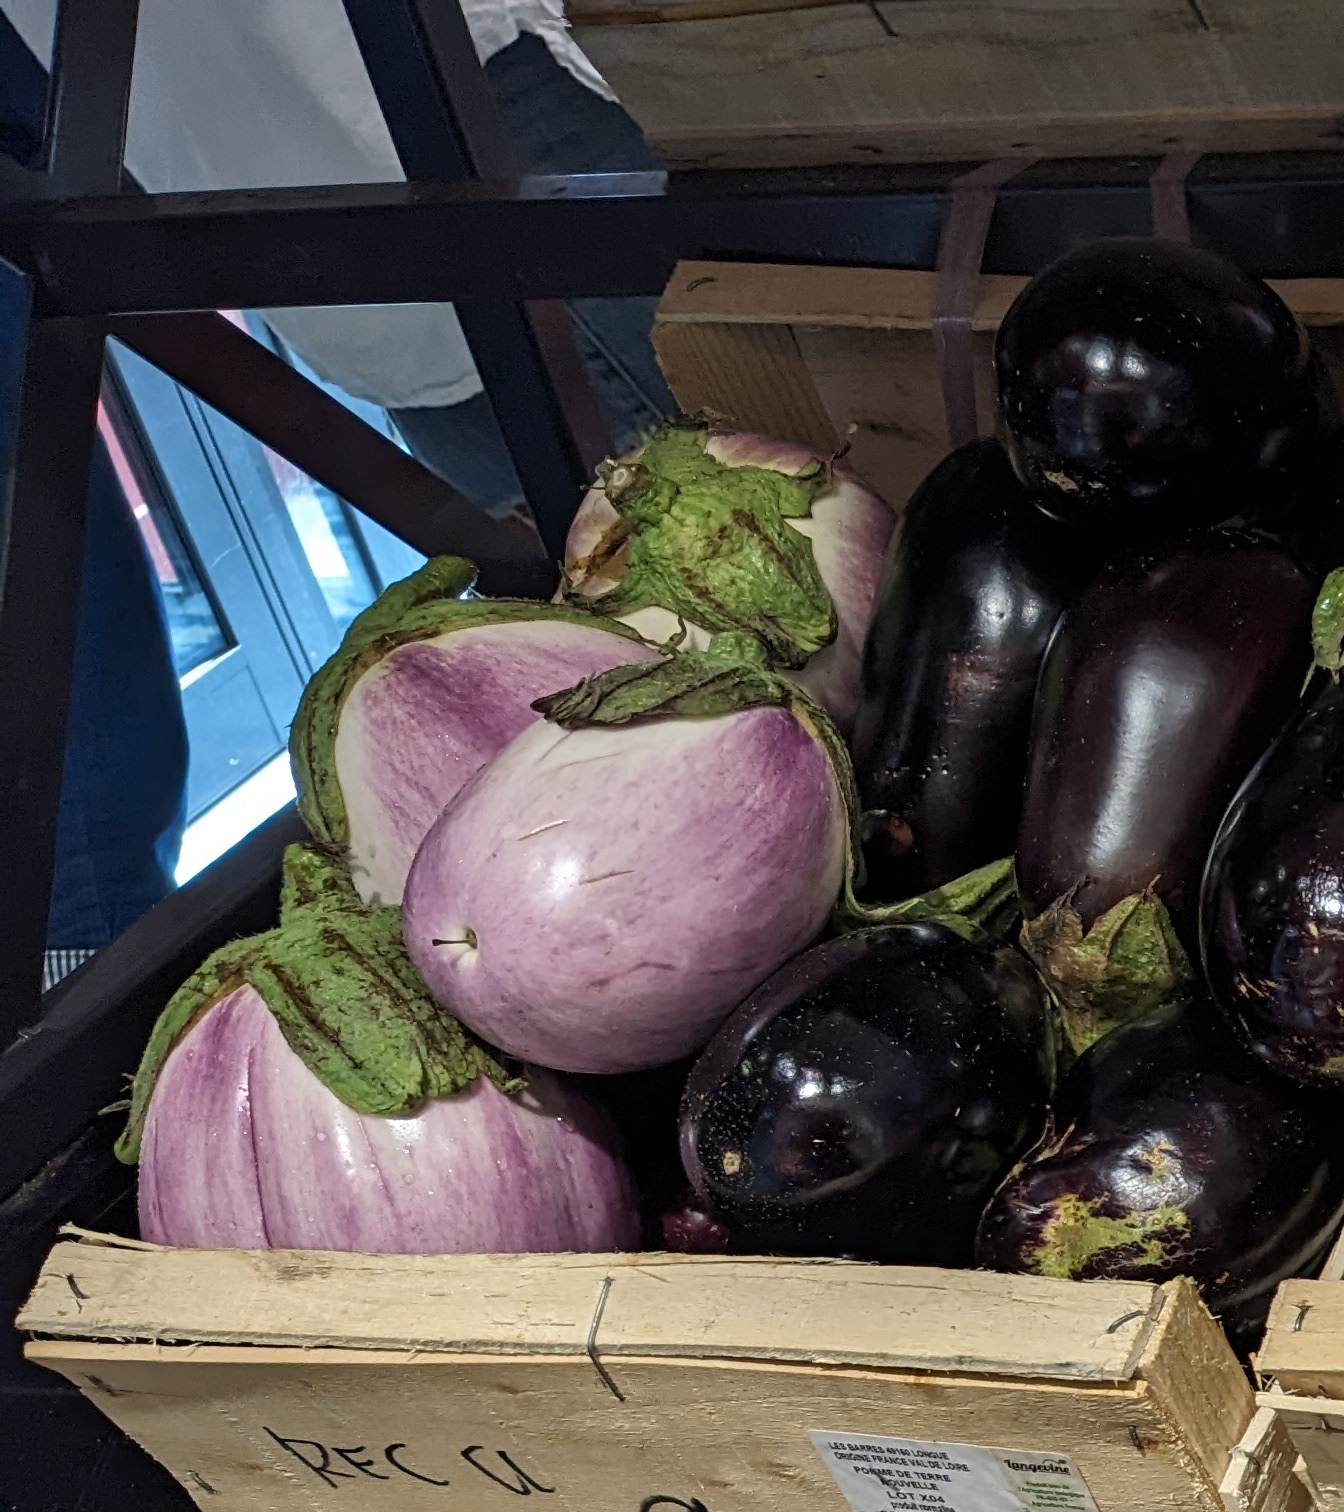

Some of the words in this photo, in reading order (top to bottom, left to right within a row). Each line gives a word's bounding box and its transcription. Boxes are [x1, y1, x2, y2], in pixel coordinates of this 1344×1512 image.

[896, 1470, 913, 1479] DE
[914, 1471, 951, 1482] TERRE
[886, 1491, 915, 1501] LOT
[919, 1494, 945, 1504] X04
